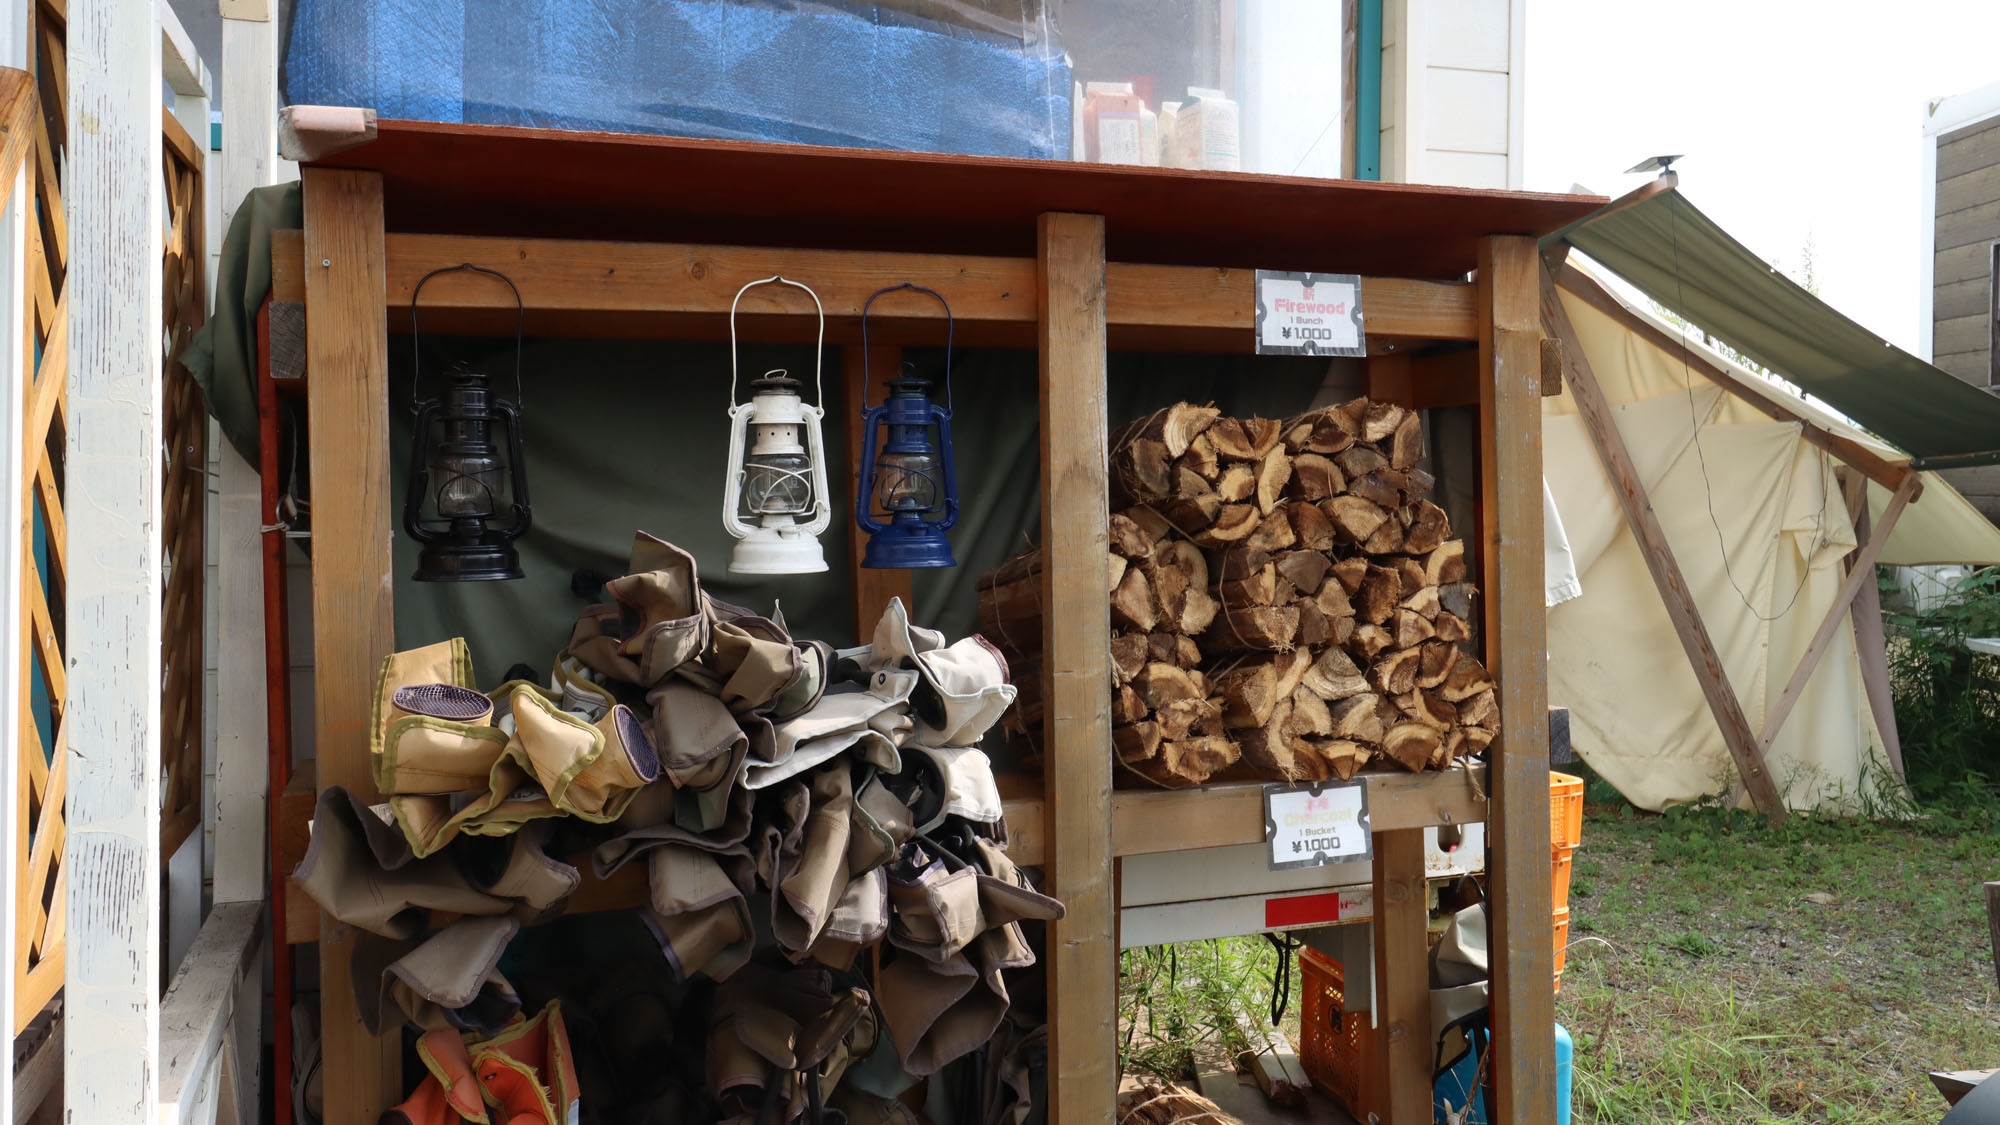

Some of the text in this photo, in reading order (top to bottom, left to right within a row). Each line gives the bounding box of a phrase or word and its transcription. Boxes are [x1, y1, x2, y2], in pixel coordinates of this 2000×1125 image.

[1274, 298, 1345, 315] Firewood
[1296, 316, 1323, 325] Bunch
[1305, 826, 1336, 836] Bucket
